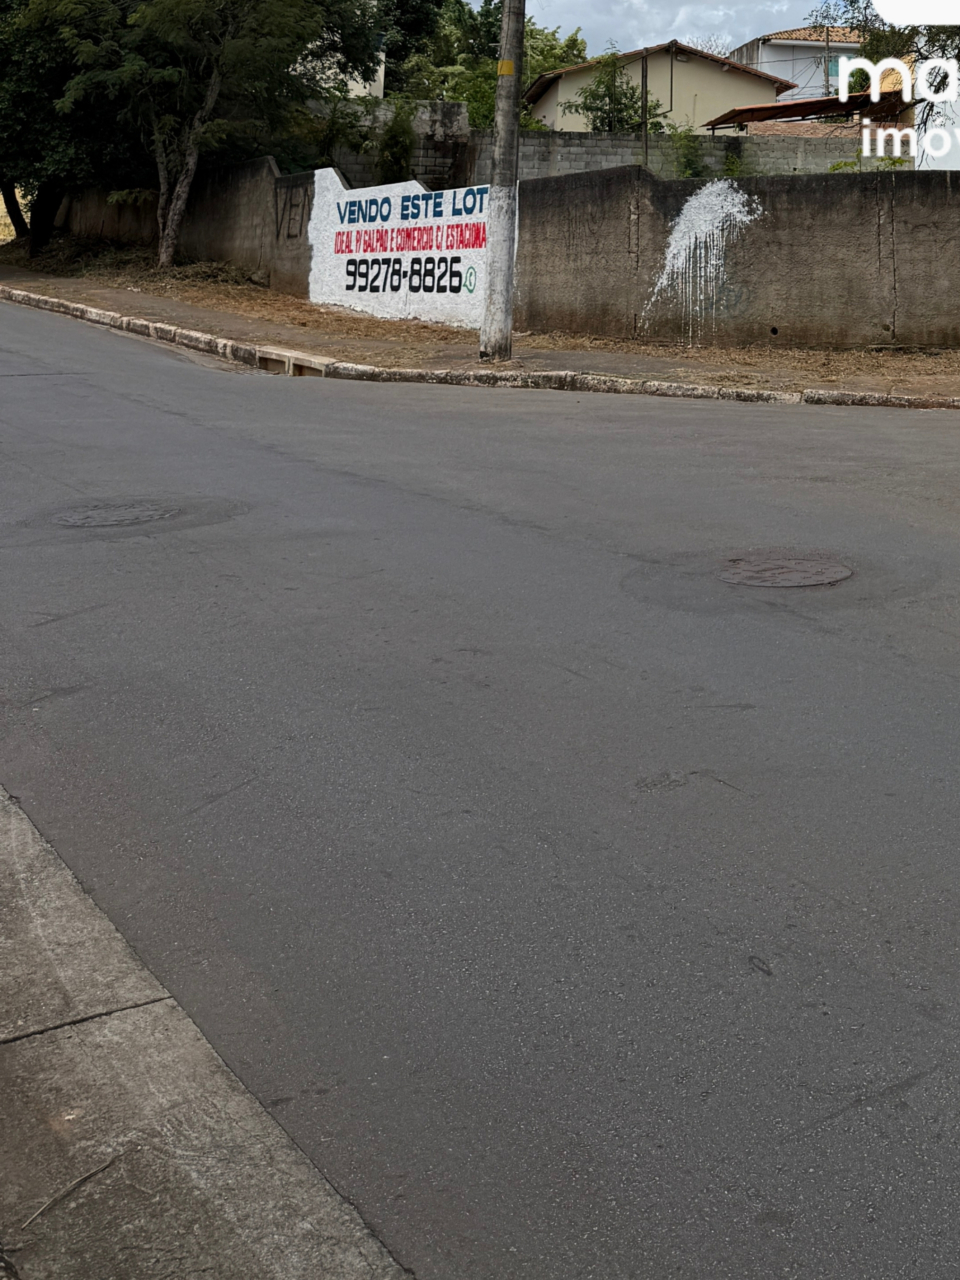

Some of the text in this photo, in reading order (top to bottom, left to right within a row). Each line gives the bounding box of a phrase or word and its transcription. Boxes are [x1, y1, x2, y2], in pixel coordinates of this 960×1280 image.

[336, 196, 392, 224] VENDO
[400, 191, 444, 220] ESTE
[334, 230, 353, 254] IDEAL
[390, 228, 395, 252] E
[345, 256, 463, 294] 99278-8826
